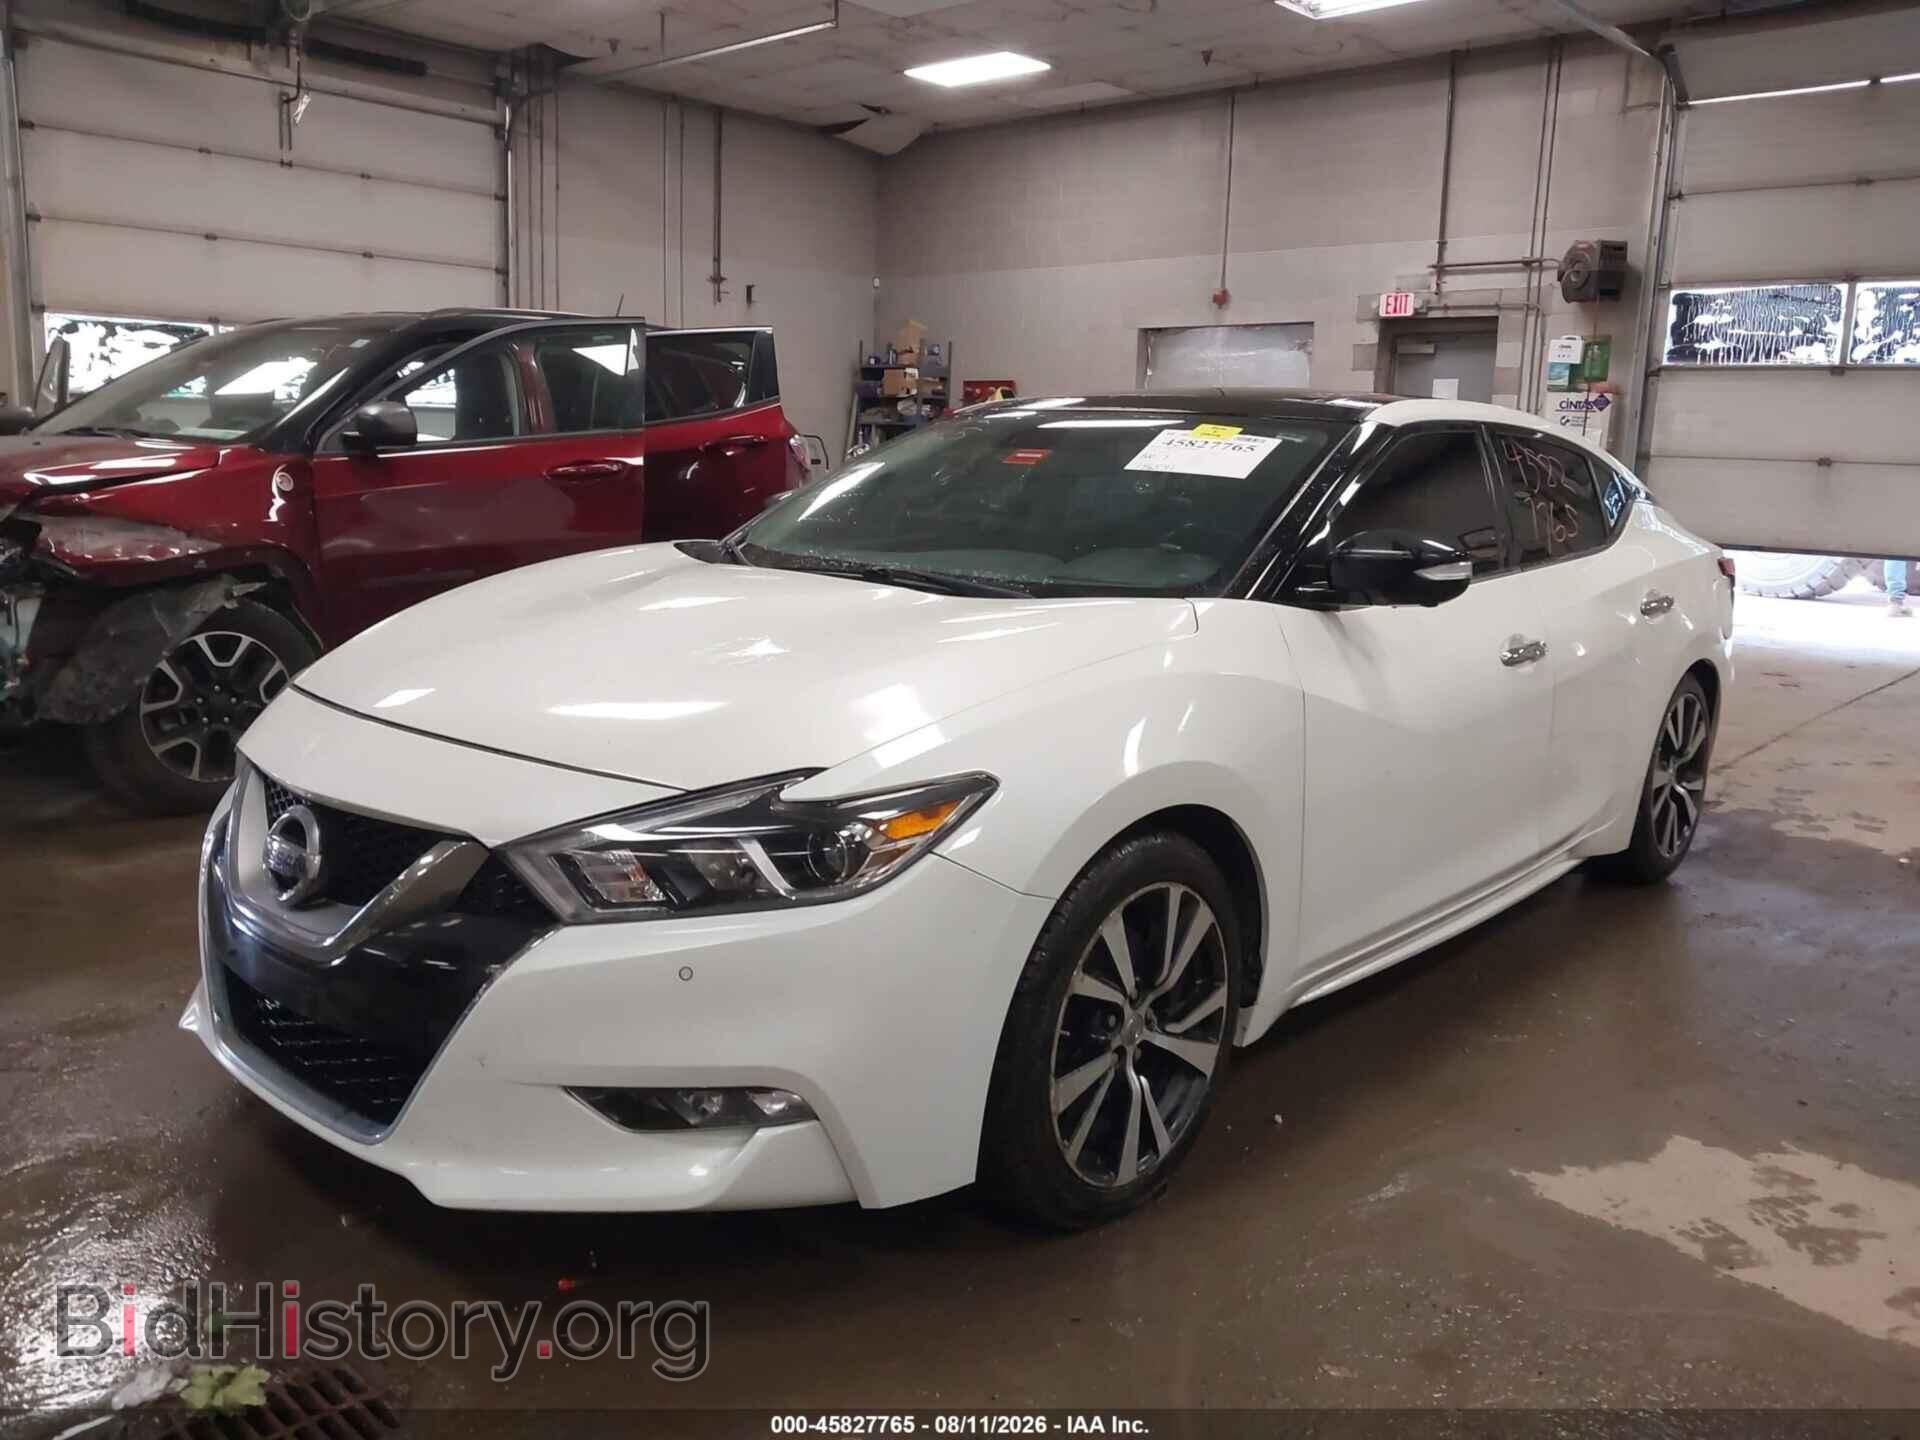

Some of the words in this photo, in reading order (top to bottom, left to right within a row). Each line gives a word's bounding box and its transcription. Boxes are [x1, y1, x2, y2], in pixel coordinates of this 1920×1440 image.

[1385, 294, 1409, 315] EXIT
[1559, 398, 1595, 410] CINTAS
[1162, 438, 1257, 453] 45827765
